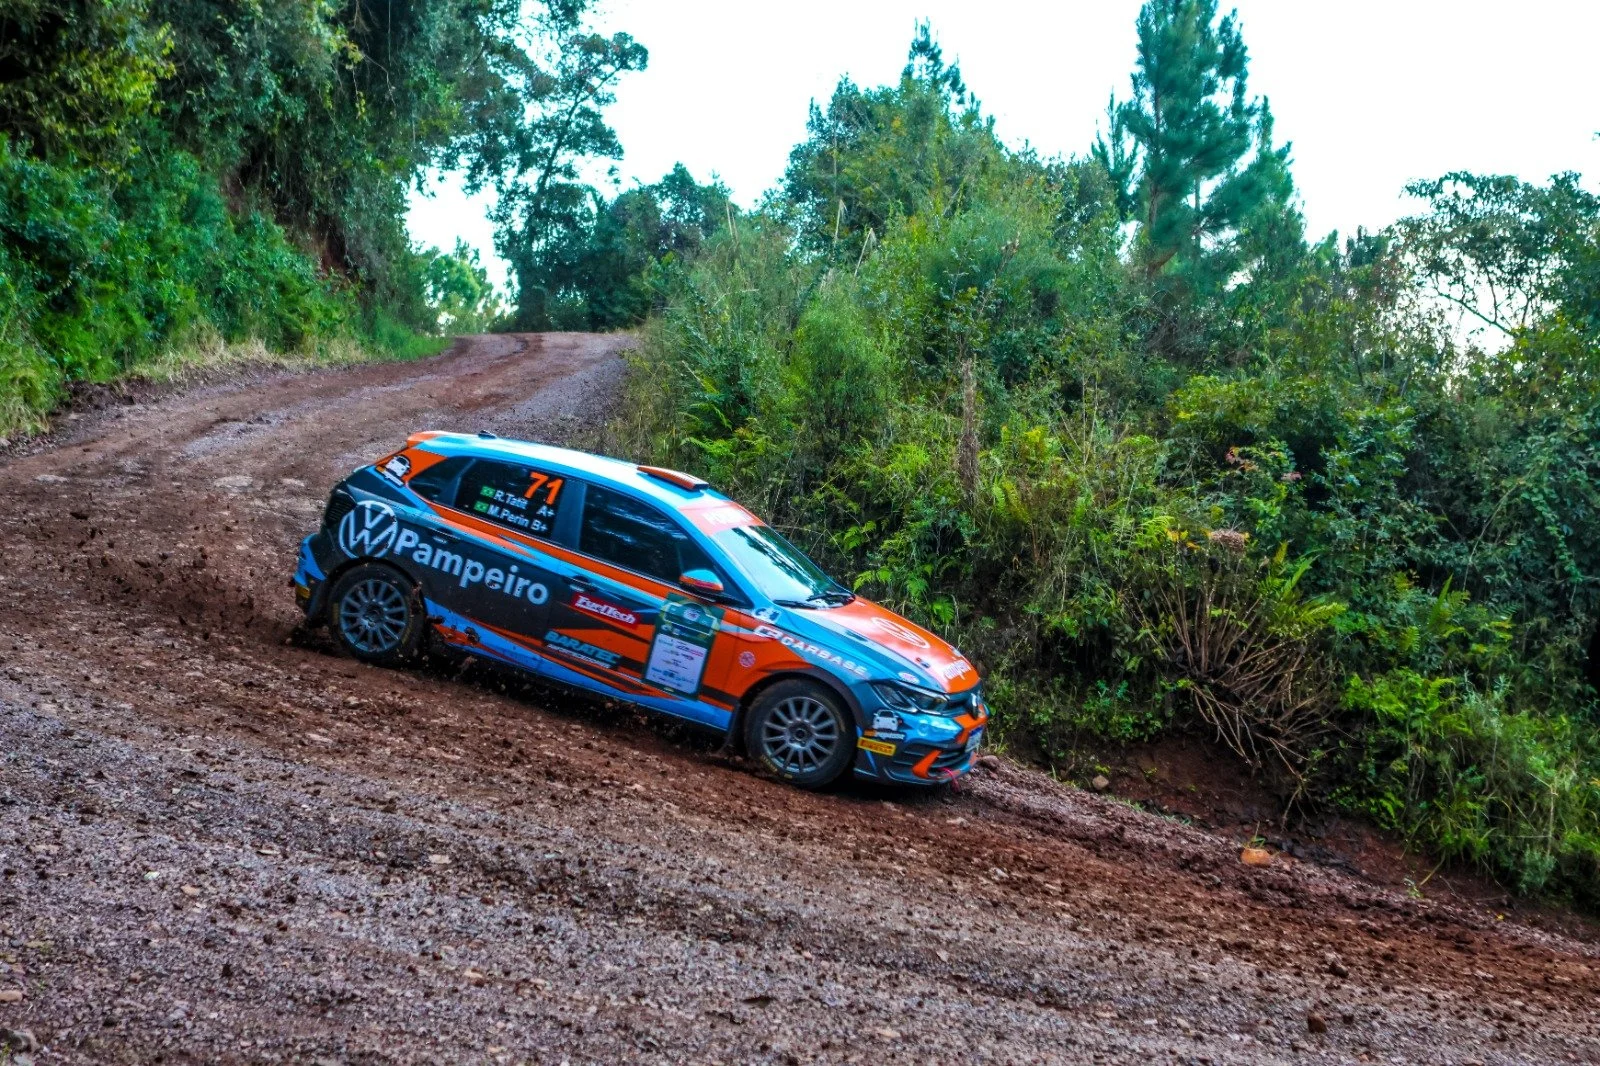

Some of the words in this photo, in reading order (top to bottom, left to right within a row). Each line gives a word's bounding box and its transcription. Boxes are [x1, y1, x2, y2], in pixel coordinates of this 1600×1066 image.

[524, 471, 563, 505] 71
[530, 519, 548, 532] B+
[536, 505, 555, 517] A+
[393, 528, 549, 605] Pampeiro
[781, 635, 868, 676] CARBASE
